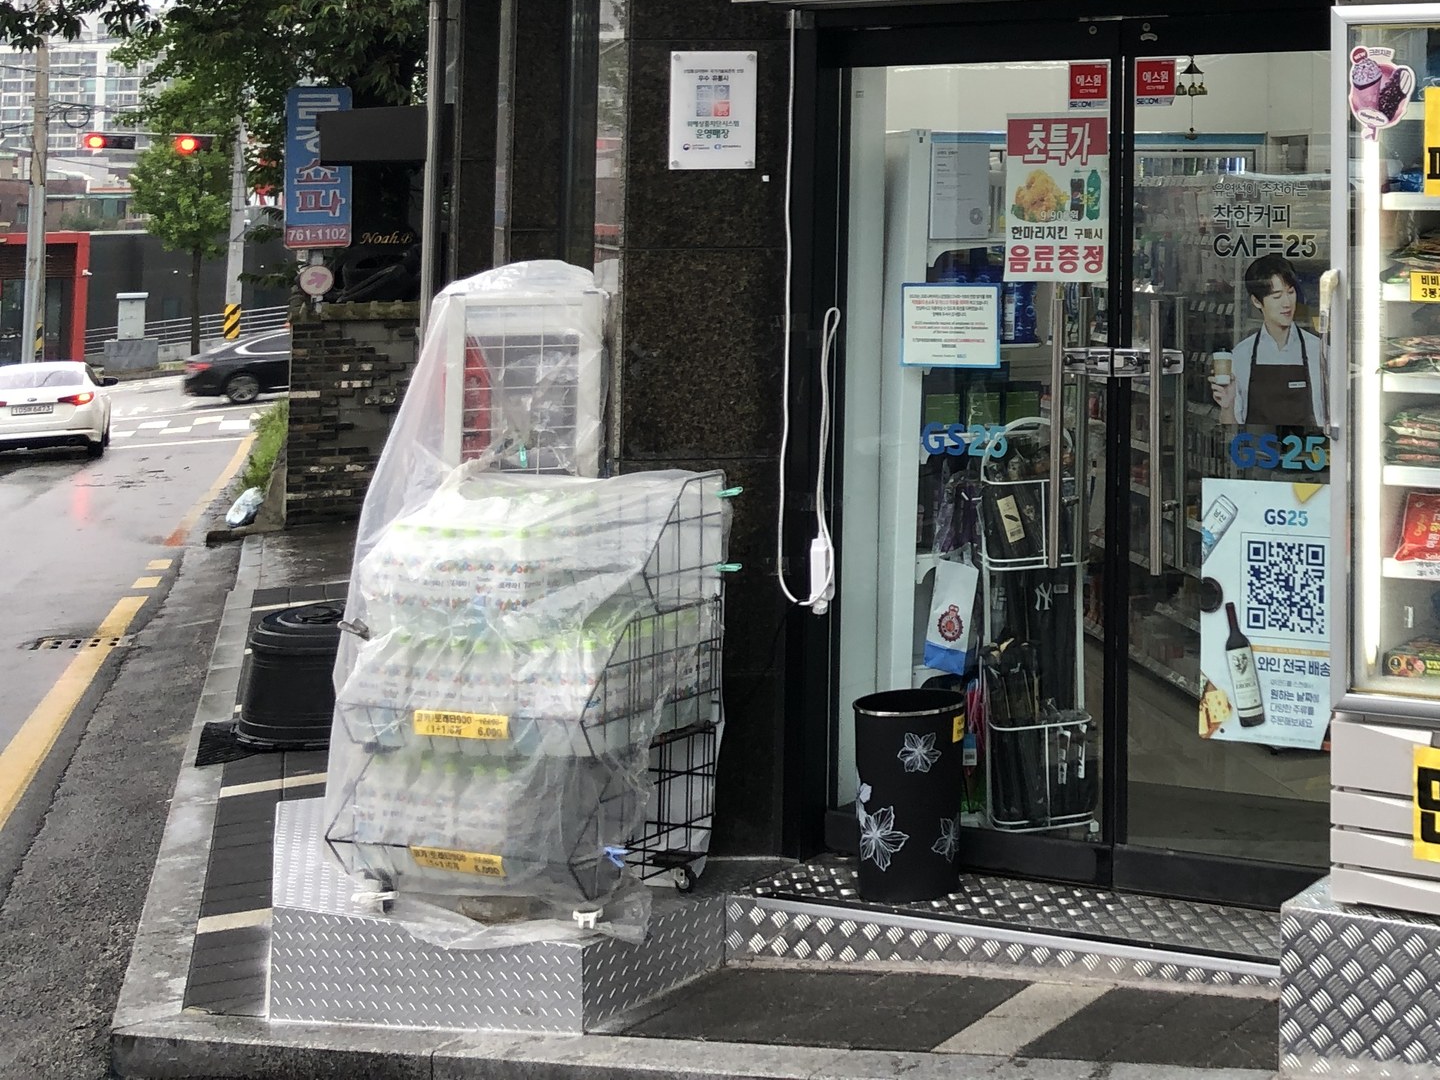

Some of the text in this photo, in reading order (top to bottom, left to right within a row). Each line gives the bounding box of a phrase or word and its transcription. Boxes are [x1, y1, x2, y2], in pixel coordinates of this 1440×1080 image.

[1075, 75, 1101, 87] 에스원
[1142, 70, 1169, 83] 에스원
[695, 128, 730, 139] 운영매장
[1023, 122, 1091, 166] 초특가
[1213, 182, 1309, 198] 유연석이 추천하는
[1213, 204, 1291, 228] 착한커피
[288, 228, 347, 242] 761-1102
[1011, 226, 1103, 240] 한마리치킨 구매시
[1213, 234, 1317, 258] CAFE25
[1008, 244, 1105, 274] 음료증정
[921, 422, 1008, 458] GS25
[1230, 434, 1327, 471] GS25
[1264, 508, 1309, 527] GS25
[1258, 656, 1331, 677] 와인 전국 배송
[1270, 689, 1294, 701] 원하는
[1270, 702, 1314, 716] 다양한 주류를
[1270, 715, 1314, 728] 주문해보세요
